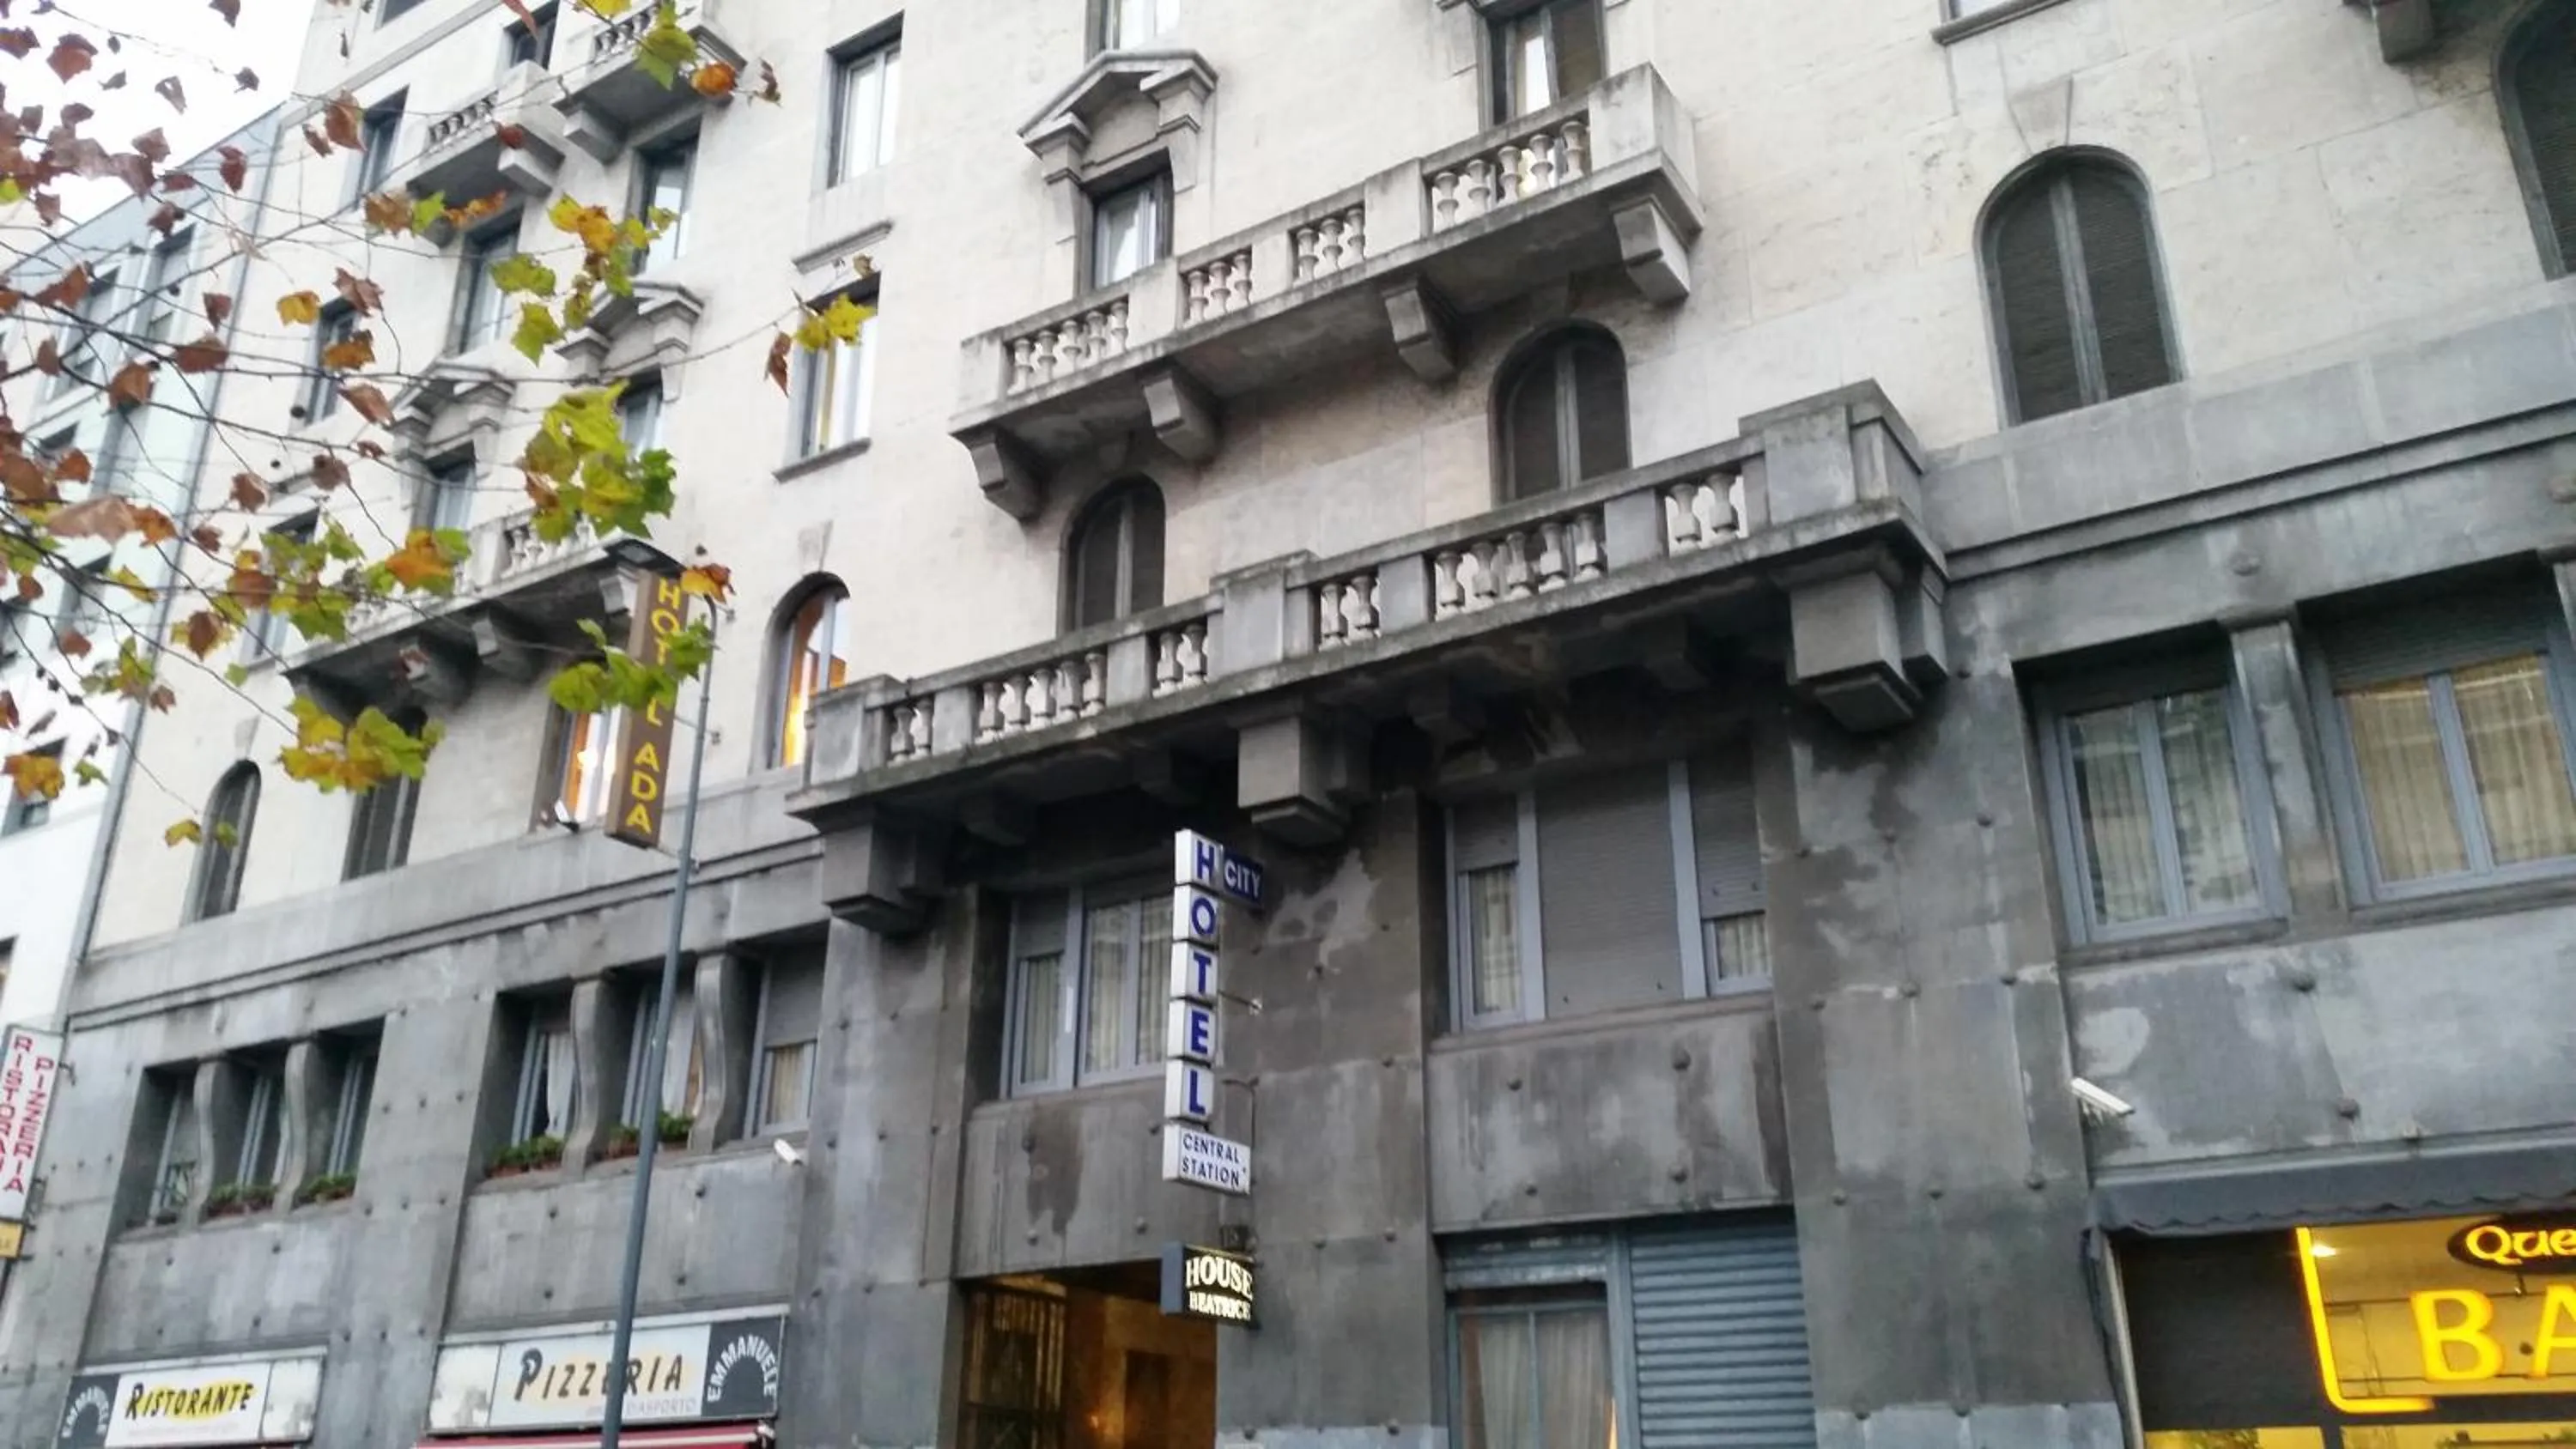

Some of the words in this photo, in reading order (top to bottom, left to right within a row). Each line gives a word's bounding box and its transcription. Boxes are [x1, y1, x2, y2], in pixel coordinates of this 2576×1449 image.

[646, 578, 680, 727] HOTL
[625, 742, 660, 834] ADA
[1224, 859, 1261, 899] CITY
[1188, 839, 1217, 1116] HOTEL
[3, 1057, 55, 1194] PIZZERIA
[1182, 1132, 1239, 1164] CENTRAL
[1182, 1157, 1239, 1187] STATION
[1185, 1255, 1254, 1300] HOUSE
[1188, 1290, 1252, 1321] BEATRICE
[2411, 1283, 2576, 1381] BA
[707, 1333, 778, 1403] EMMANUELE
[125, 1382, 254, 1421] RISTORANTE
